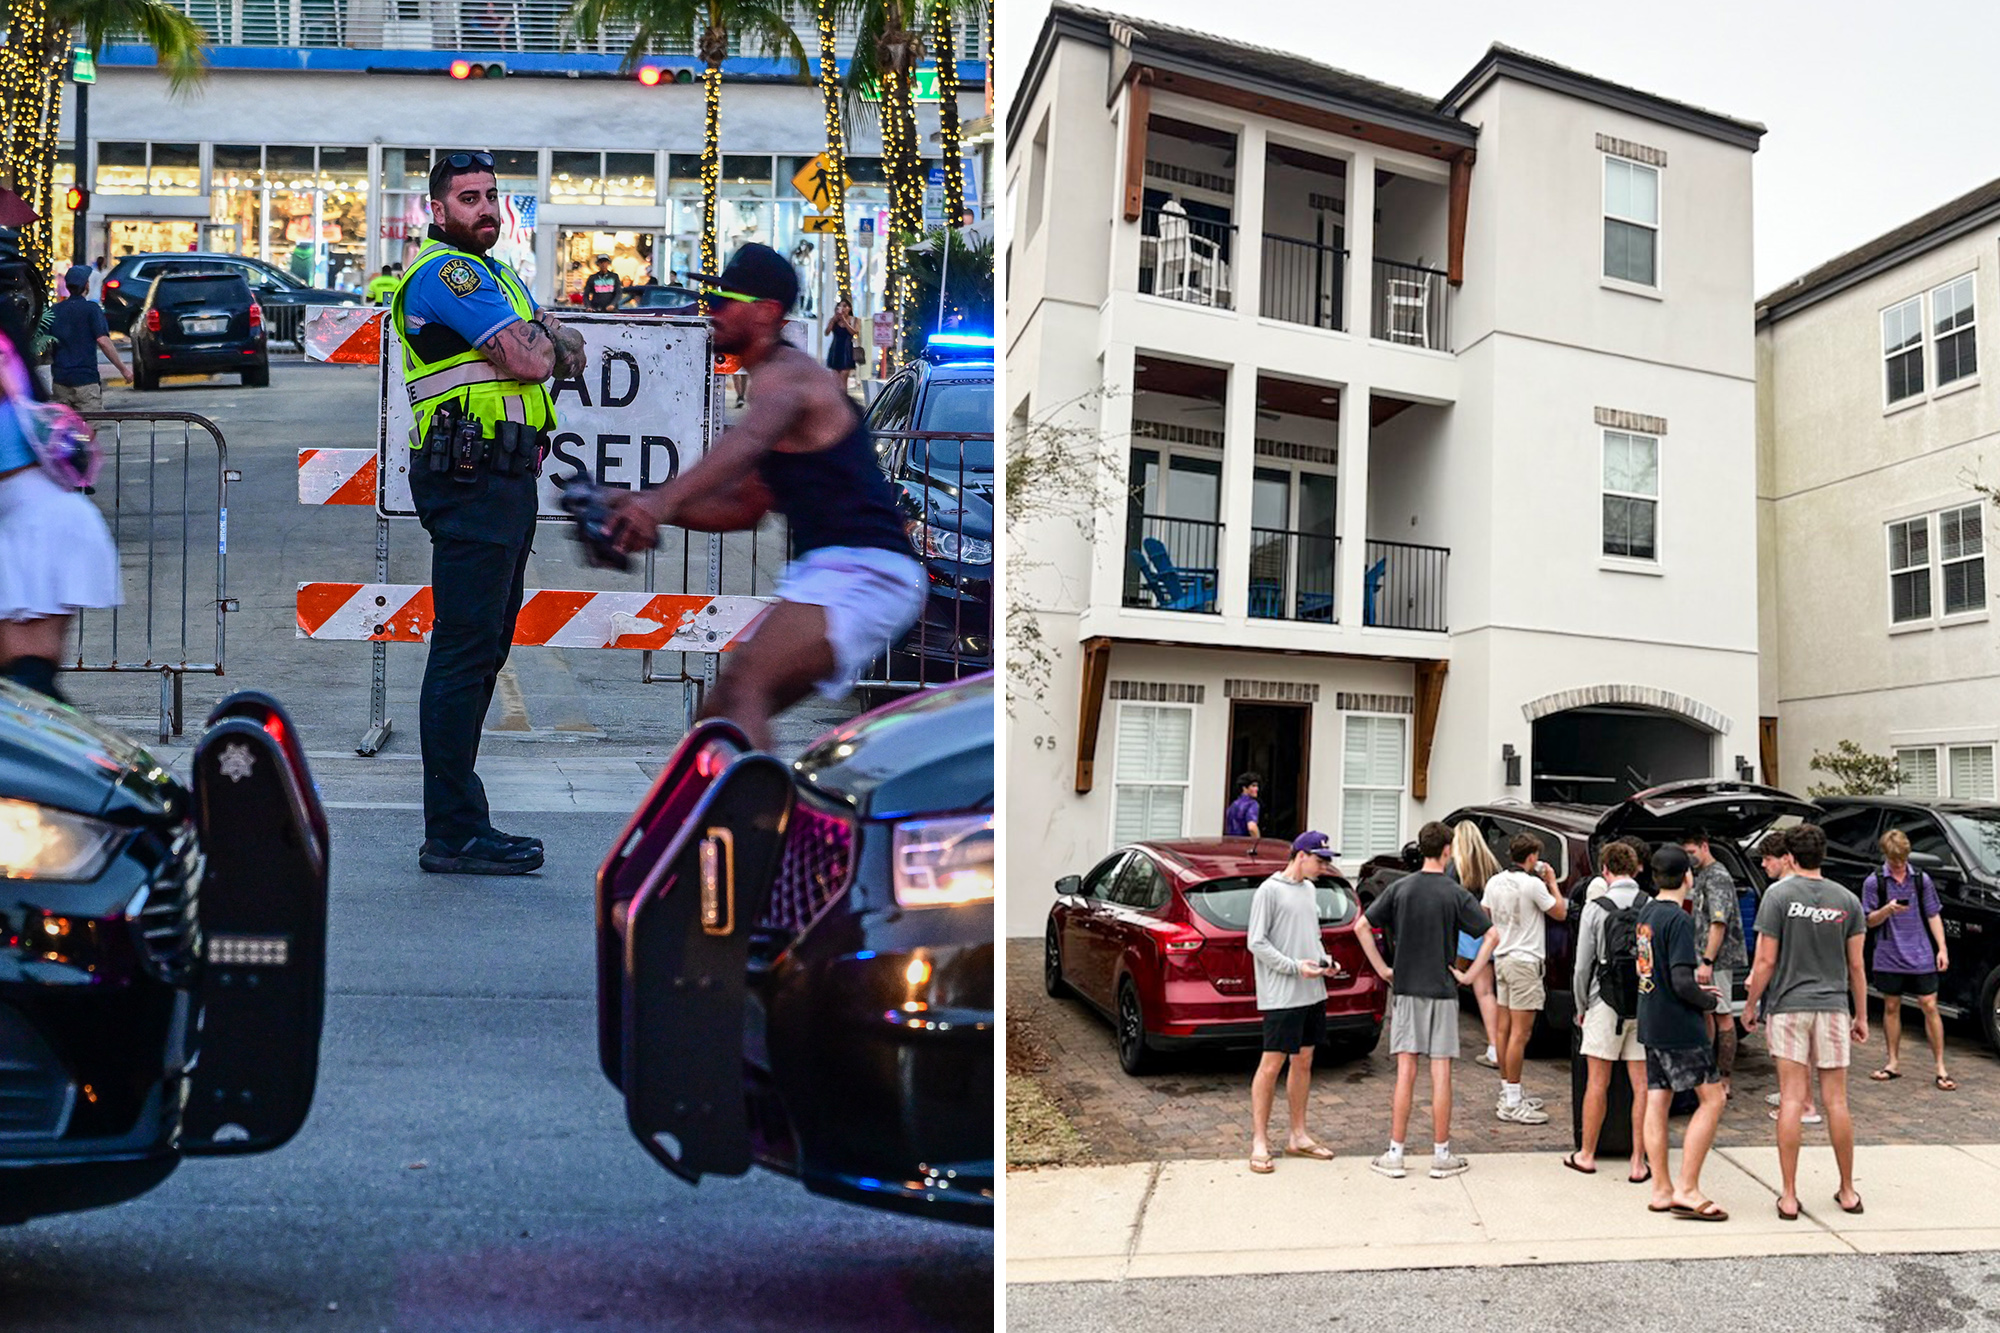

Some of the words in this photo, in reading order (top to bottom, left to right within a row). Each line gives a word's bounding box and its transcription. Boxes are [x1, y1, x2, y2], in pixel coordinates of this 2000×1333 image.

[380, 225, 408, 240] SALE
[441, 260, 465, 277] POLICE
[552, 350, 640, 407] AD
[546, 432, 679, 493] SED
[1034, 735, 1056, 750] 95
[1787, 902, 1842, 923] Burger
